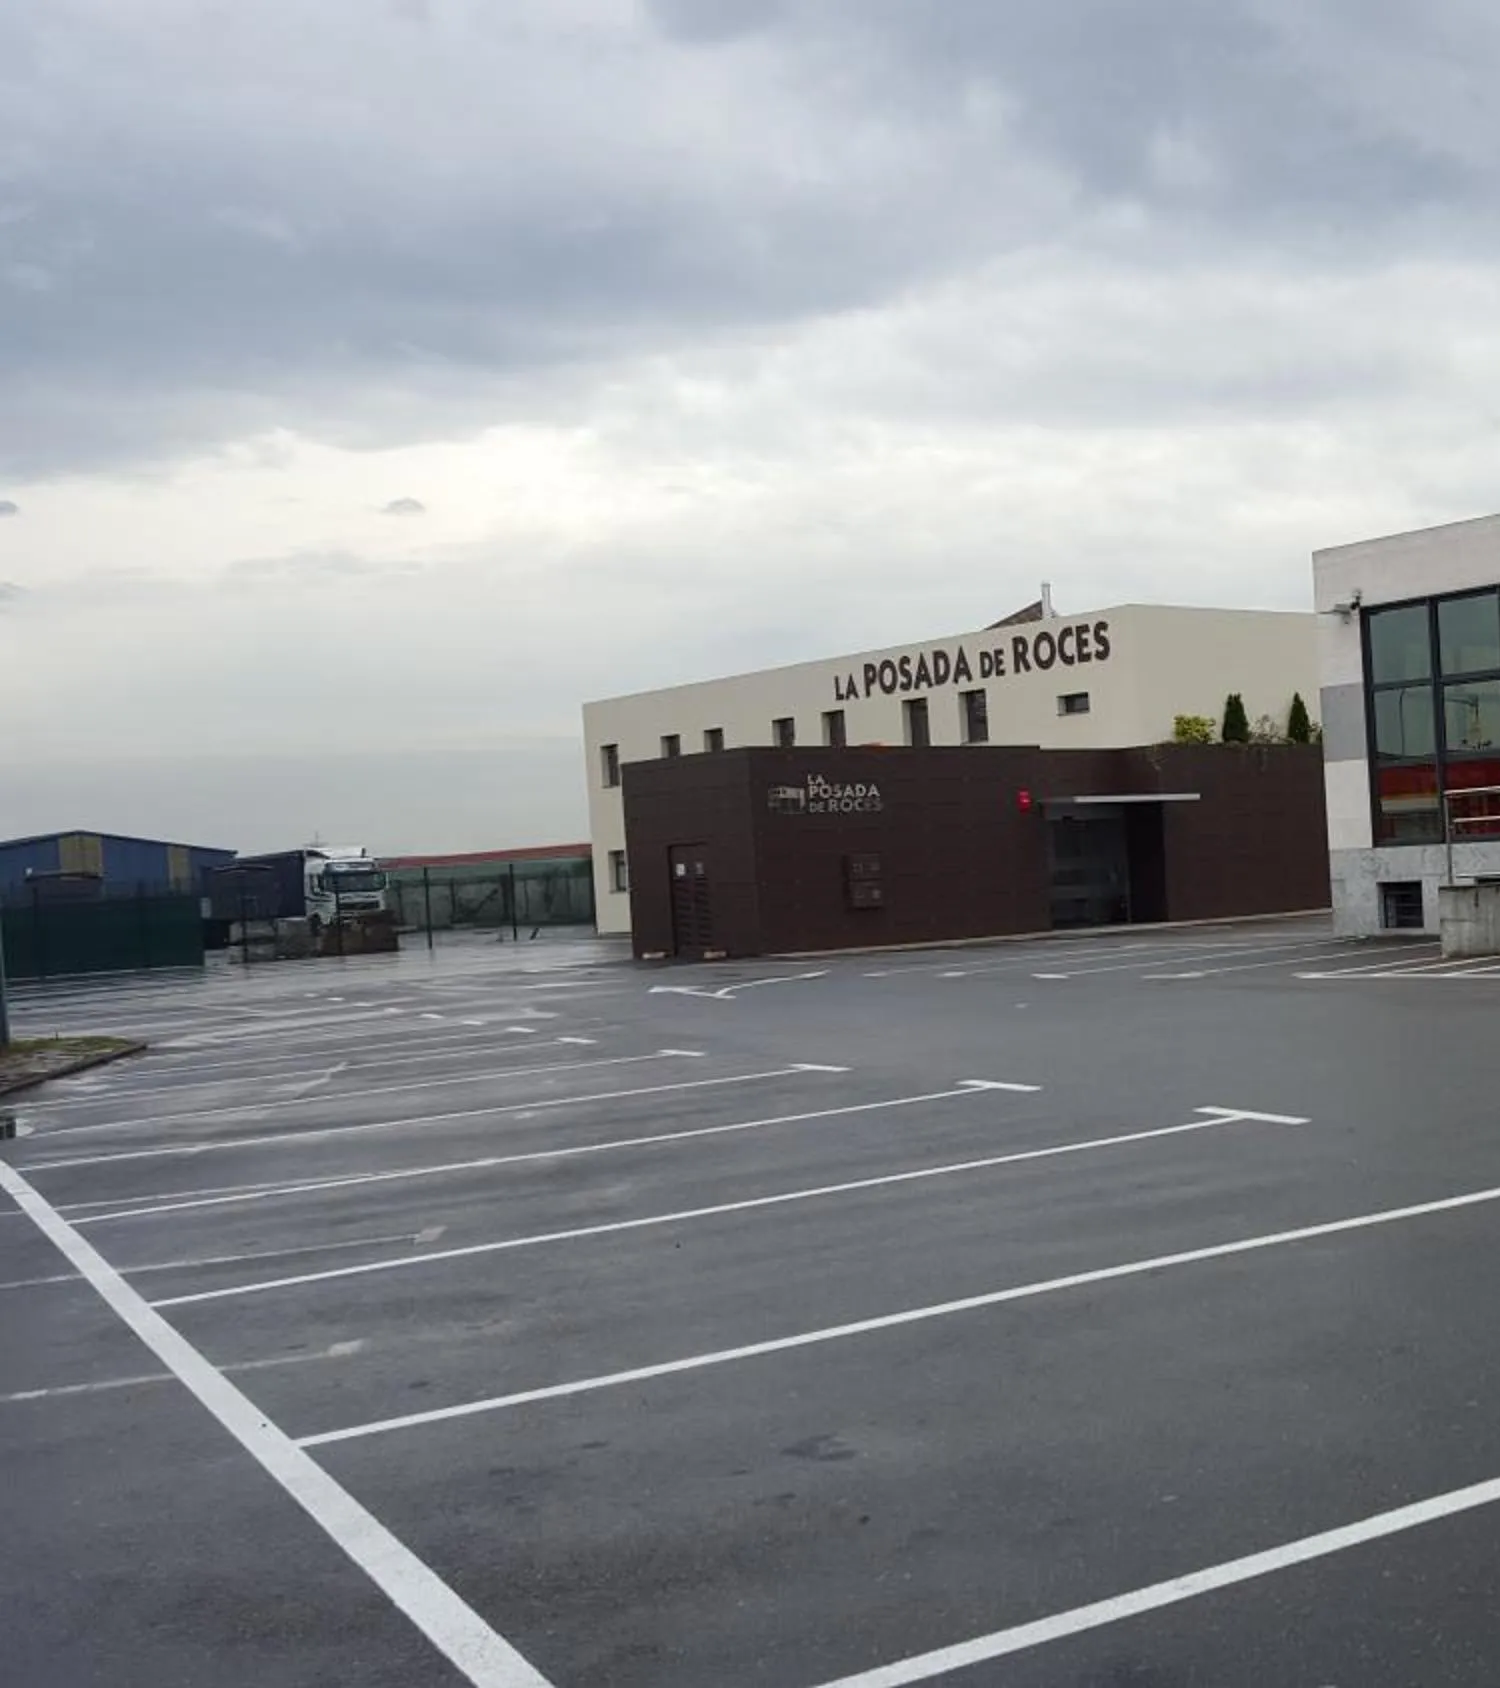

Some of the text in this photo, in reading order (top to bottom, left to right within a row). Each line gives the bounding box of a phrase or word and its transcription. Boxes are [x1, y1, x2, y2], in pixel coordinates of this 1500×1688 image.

[834, 621, 1111, 701] LA POSADA DE ROCES
[807, 774, 825, 785] LA
[809, 784, 880, 798] POSADA
[809, 799, 882, 813] DE ROCES
